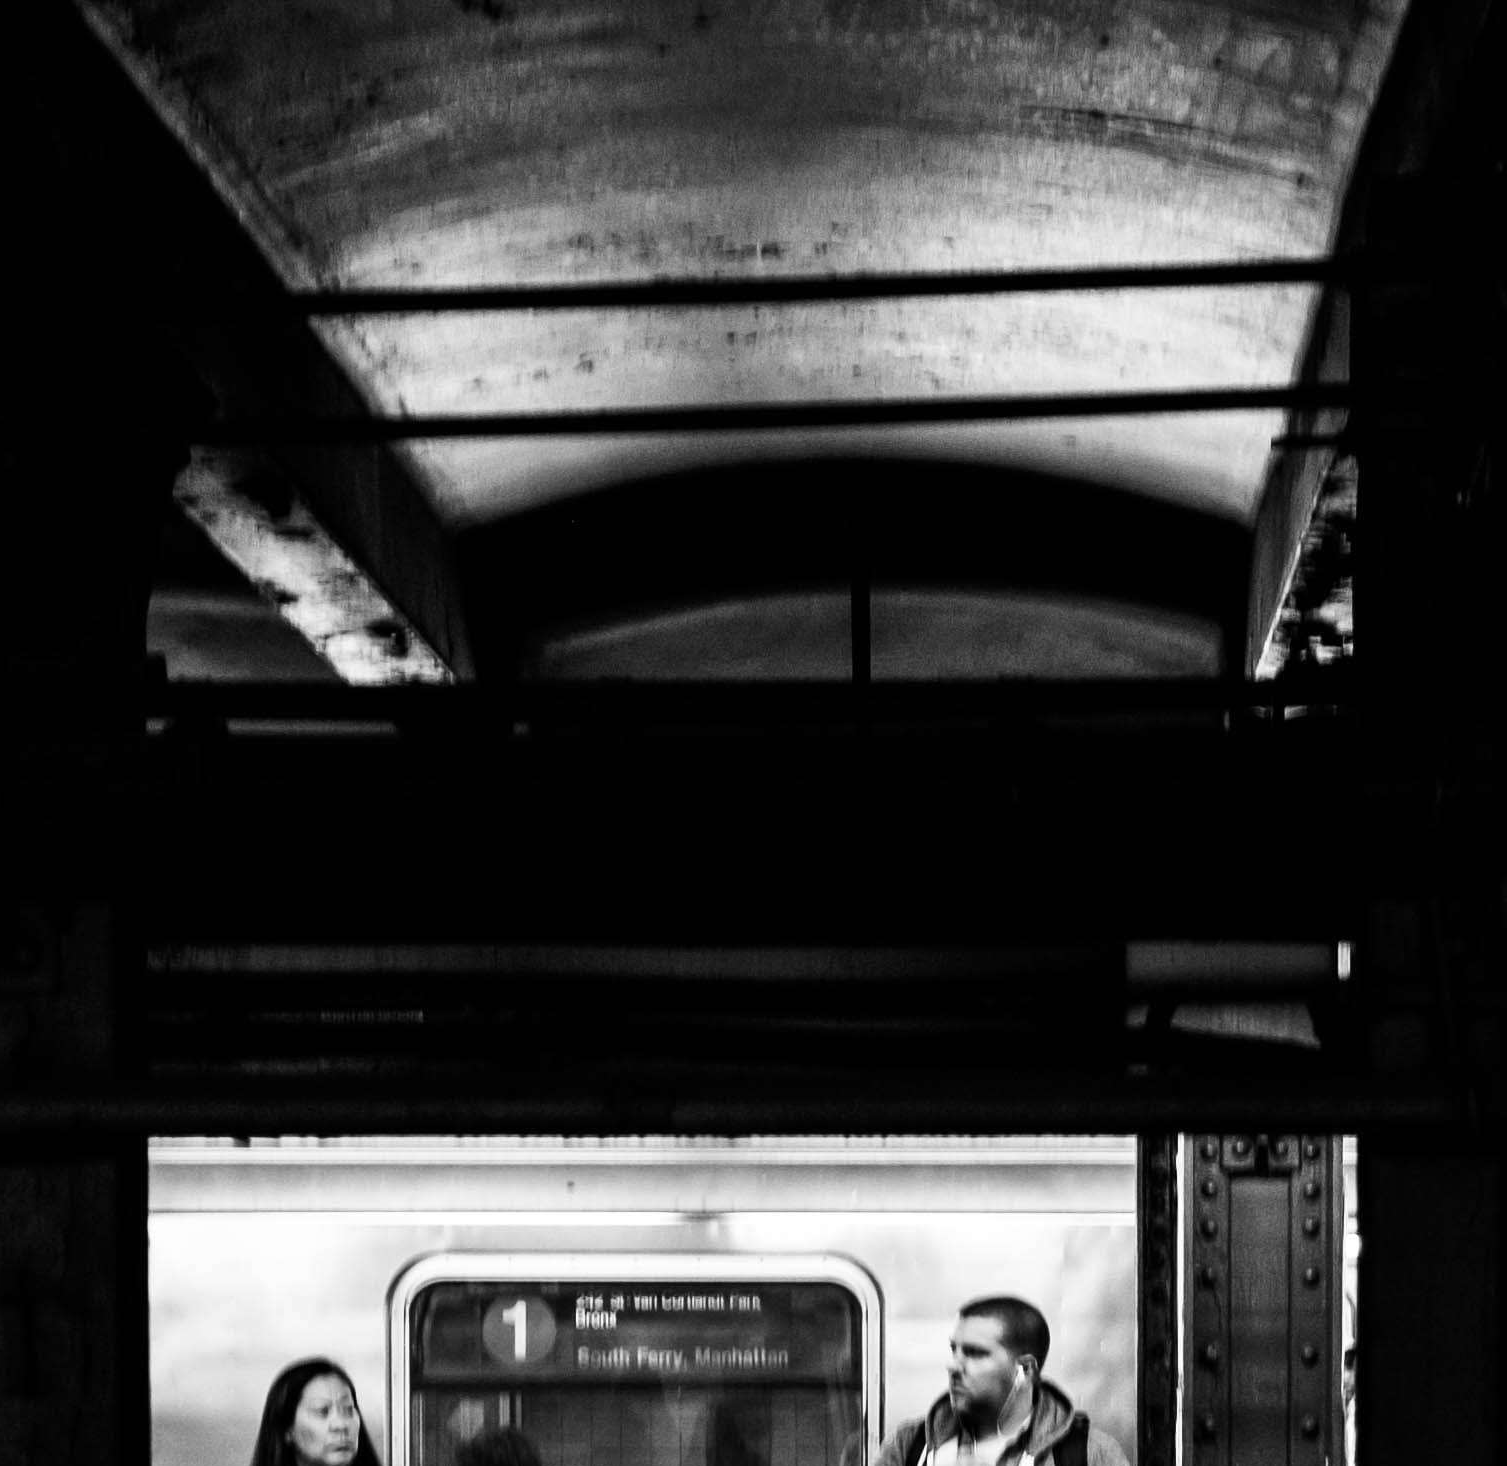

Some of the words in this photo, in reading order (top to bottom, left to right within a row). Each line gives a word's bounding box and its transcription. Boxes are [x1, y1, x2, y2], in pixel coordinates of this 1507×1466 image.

[503, 1300, 526, 1361] 1
[575, 1308, 617, 1329] Bronx
[577, 1346, 630, 1369] South
[695, 1346, 788, 1370] Manhattan
